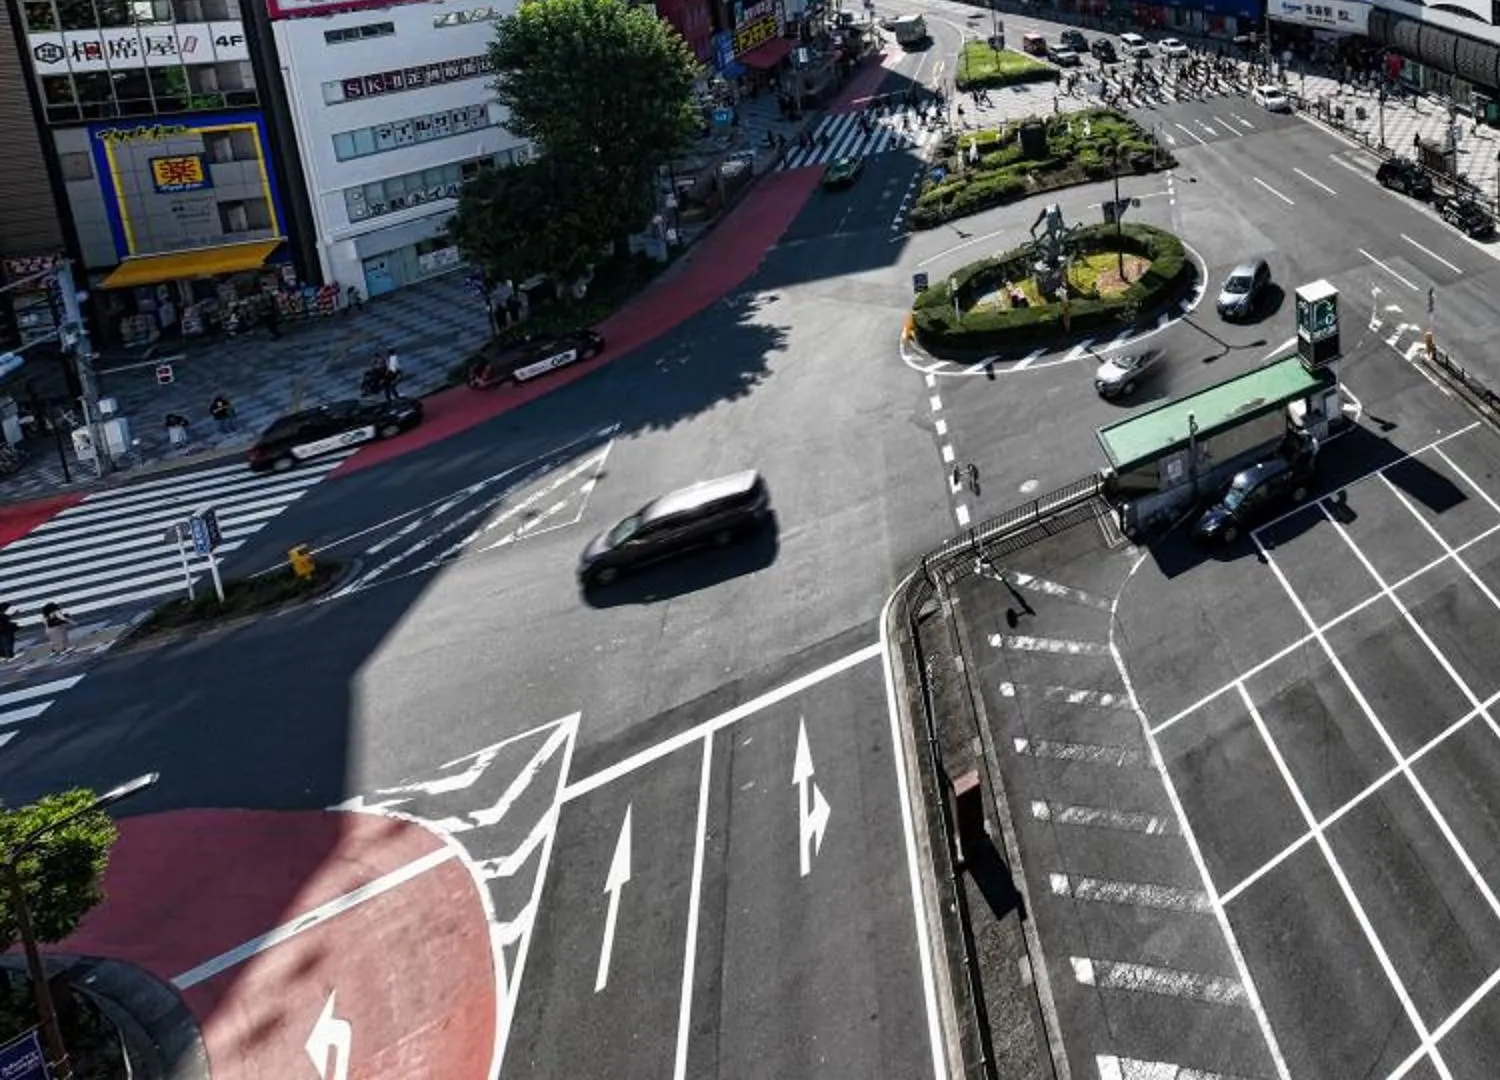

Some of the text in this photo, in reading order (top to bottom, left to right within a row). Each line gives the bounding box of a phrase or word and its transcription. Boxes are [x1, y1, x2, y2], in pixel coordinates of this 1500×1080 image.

[71, 34, 179, 62] 相席屋
[215, 35, 243, 47] 4F
